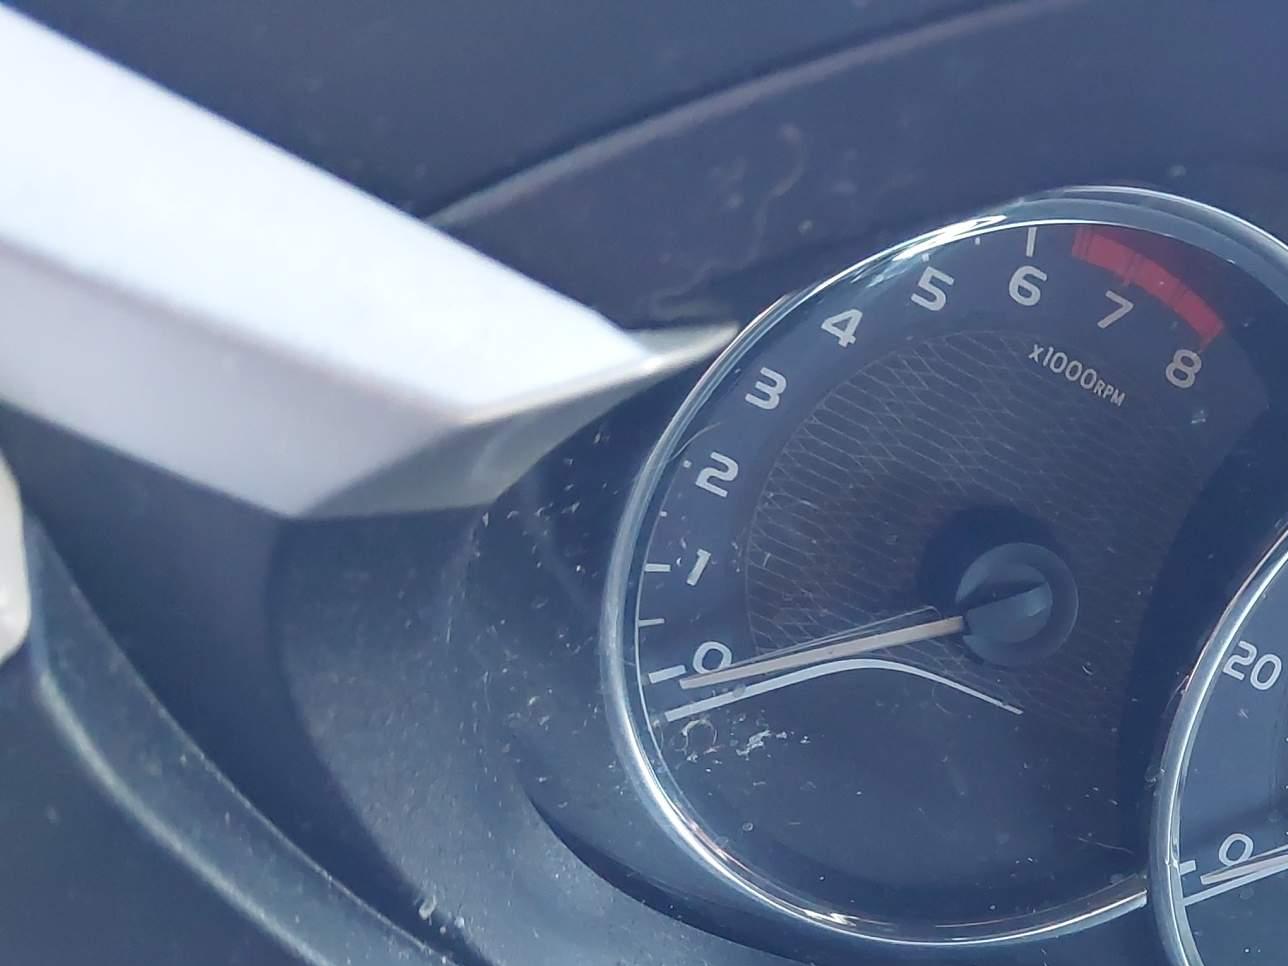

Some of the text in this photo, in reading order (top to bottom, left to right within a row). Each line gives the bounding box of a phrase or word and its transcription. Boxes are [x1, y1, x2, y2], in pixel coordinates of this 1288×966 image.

[910, 265, 955, 312] 5
[1008, 265, 1048, 307] 6
[820, 308, 863, 348] 4
[1097, 289, 1134, 329] 7
[744, 367, 788, 411] 3
[1164, 348, 1203, 389] 8
[695, 451, 739, 498] 2
[686, 548, 712, 586] 1
[692, 640, 733, 675] 0
[1222, 640, 1283, 691] 20
[1218, 832, 1255, 867] 0
